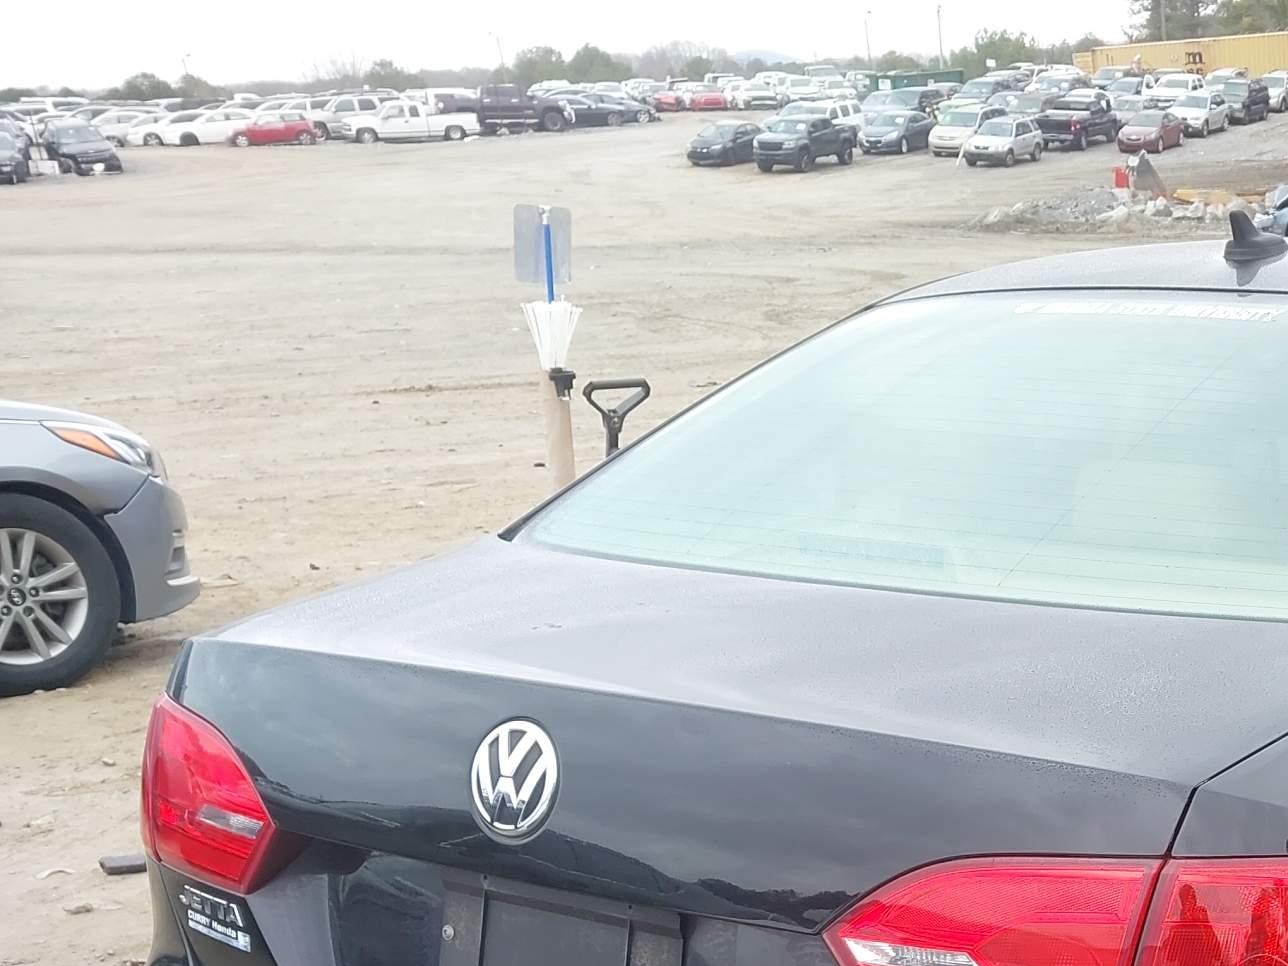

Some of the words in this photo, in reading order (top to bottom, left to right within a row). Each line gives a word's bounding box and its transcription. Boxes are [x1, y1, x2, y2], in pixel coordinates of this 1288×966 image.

[179, 884, 244, 927] JETTA
[187, 908, 211, 928] CURRY
[211, 919, 238, 939] Honda
